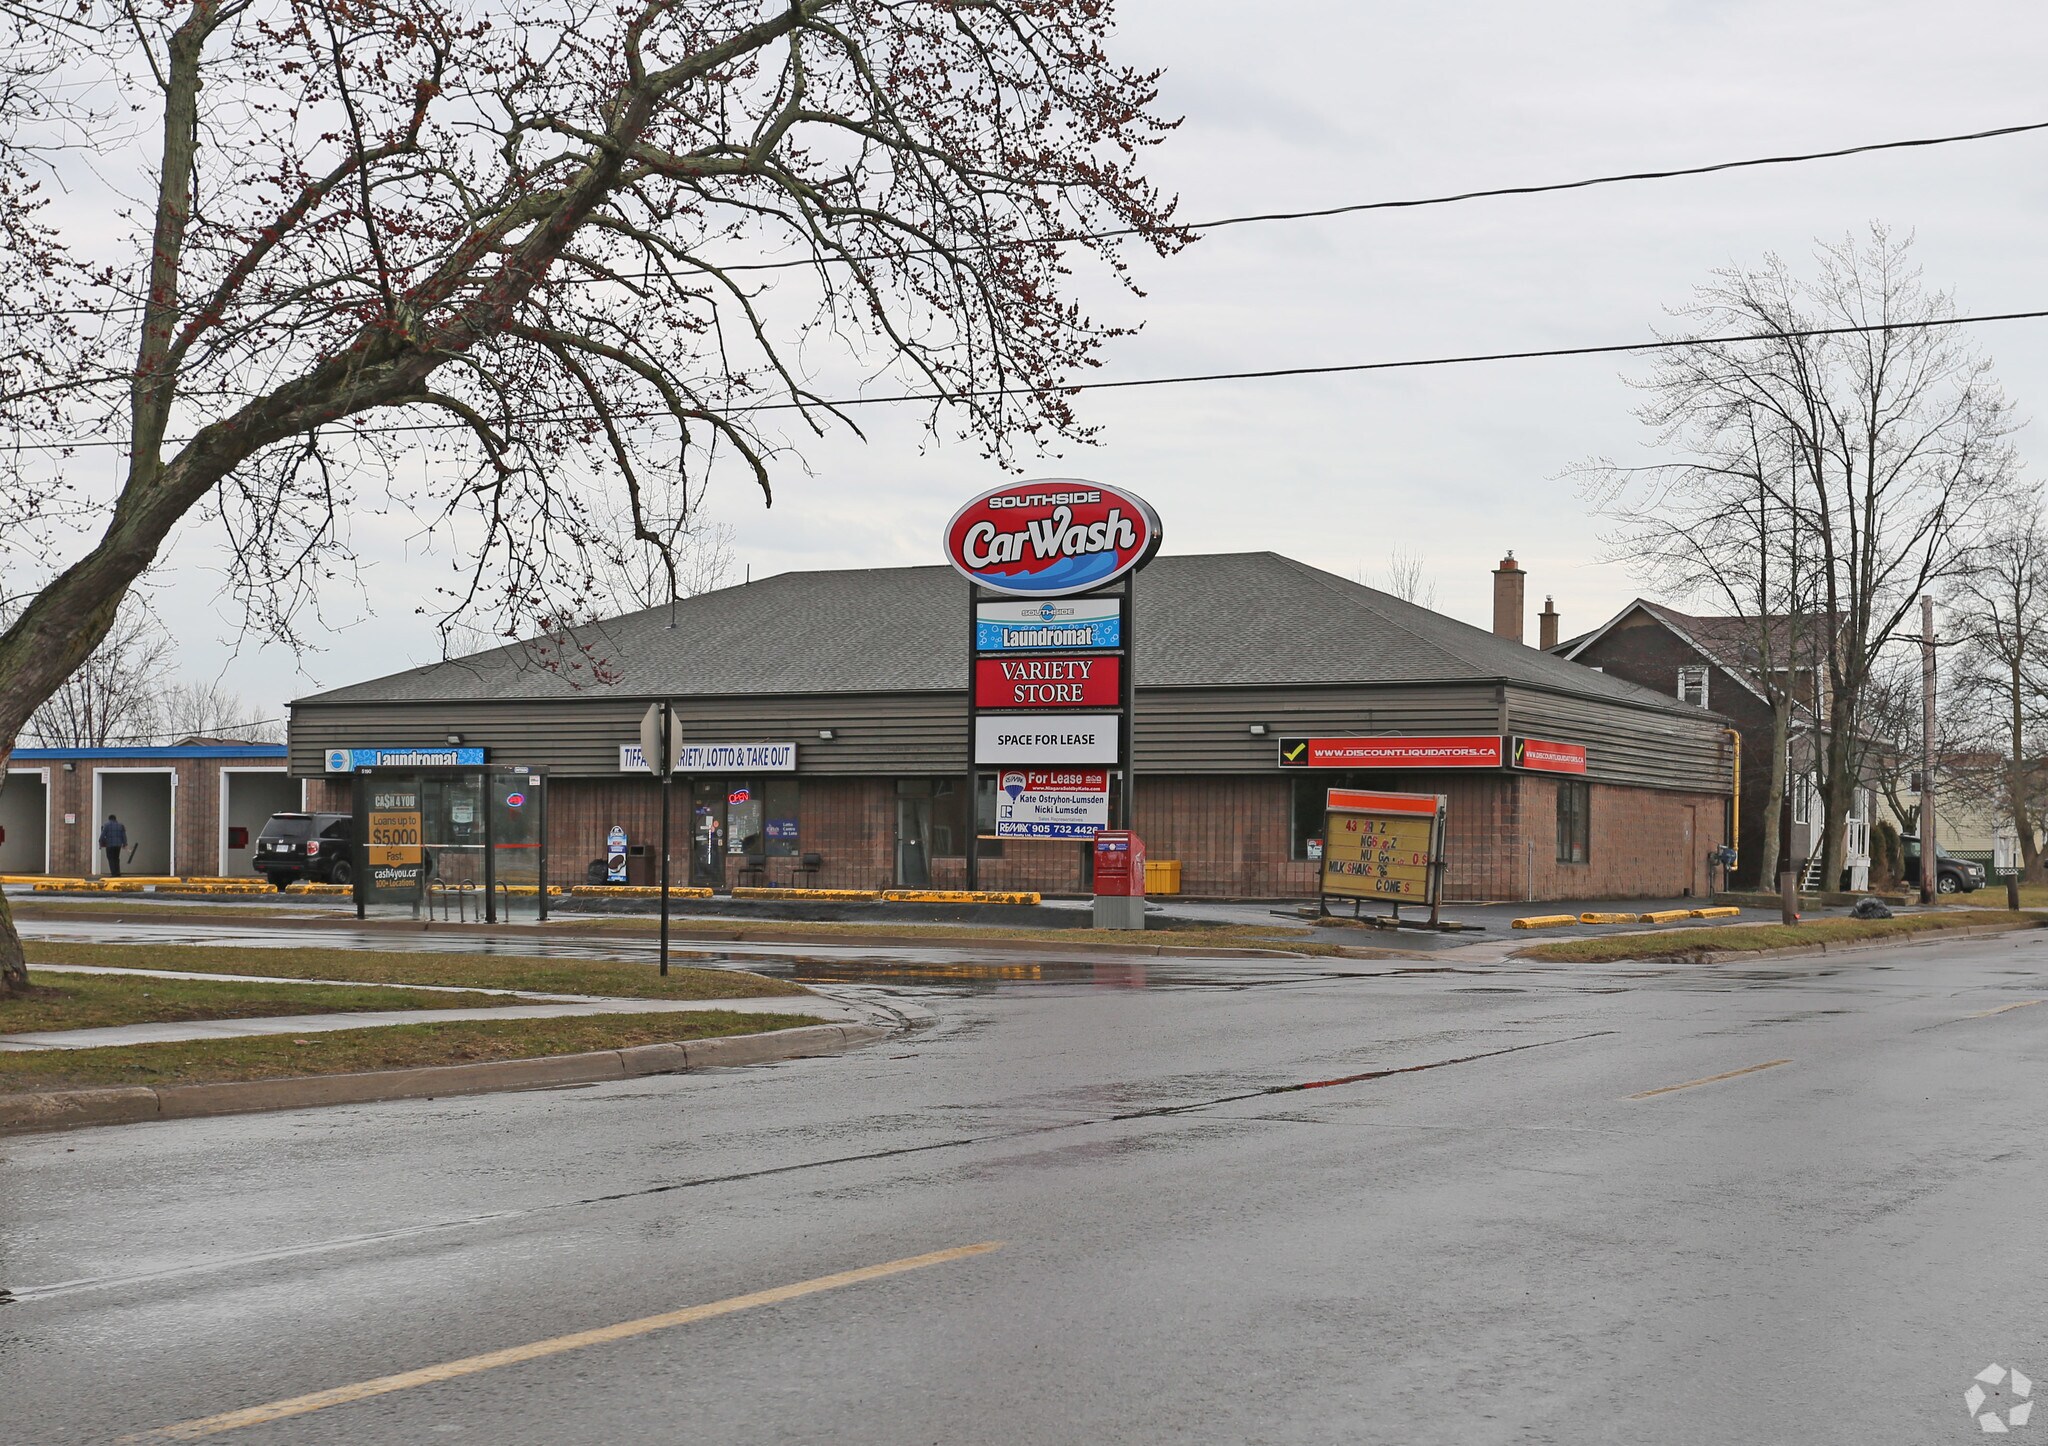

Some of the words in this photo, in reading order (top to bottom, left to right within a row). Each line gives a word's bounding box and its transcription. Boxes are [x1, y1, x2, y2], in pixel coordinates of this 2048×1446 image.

[989, 491, 1101, 509] SOUTHSIDE
[963, 506, 1136, 569] CarWash
[1021, 608, 1074, 616] SOUTHSIDE
[1003, 628, 1093, 647] Laundromat
[1001, 660, 1093, 680] VARIETY
[1014, 684, 1084, 702] STORE
[997, 735, 1032, 745] SPACE
[1035, 735, 1057, 745] FOR
[1060, 734, 1095, 745] LEASE
[376, 751, 458, 765] Laundromat
[677, 748, 705, 770] RIETY,
[707, 748, 735, 766] LOTTO
[736, 748, 744, 766] &
[746, 748, 769, 766] TAKE
[771, 747, 790, 765] OUT
[1315, 749, 1496, 757] WWW.DISCOUNTLIQUIDATORS.CA
[1028, 772, 1048, 784] For
[1051, 772, 1082, 784] Lease
[395, 796, 401, 807] 4
[401, 795, 415, 807] YOU
[729, 792, 749, 802] OPEN
[1020, 795, 1036, 803] Kate
[1039, 795, 1104, 805] Ostryhon-Lumsden
[1035, 806, 1053, 814] Nicki
[1055, 806, 1087, 814] Lumsden
[373, 816, 396, 825] Loans
[398, 818, 408, 827] up
[409, 816, 416, 825] to
[1346, 820, 1357, 831] 43
[1000, 823, 1028, 832] RE/MAX
[1032, 825, 1050, 833] 905
[1053, 825, 1072, 833] 732
[373, 827, 417, 849] $5,000
[386, 852, 403, 861] Fast.
[1329, 861, 1345, 873] MILK
[375, 868, 416, 880] cash4you.ca
[389, 879, 415, 887] Locations
